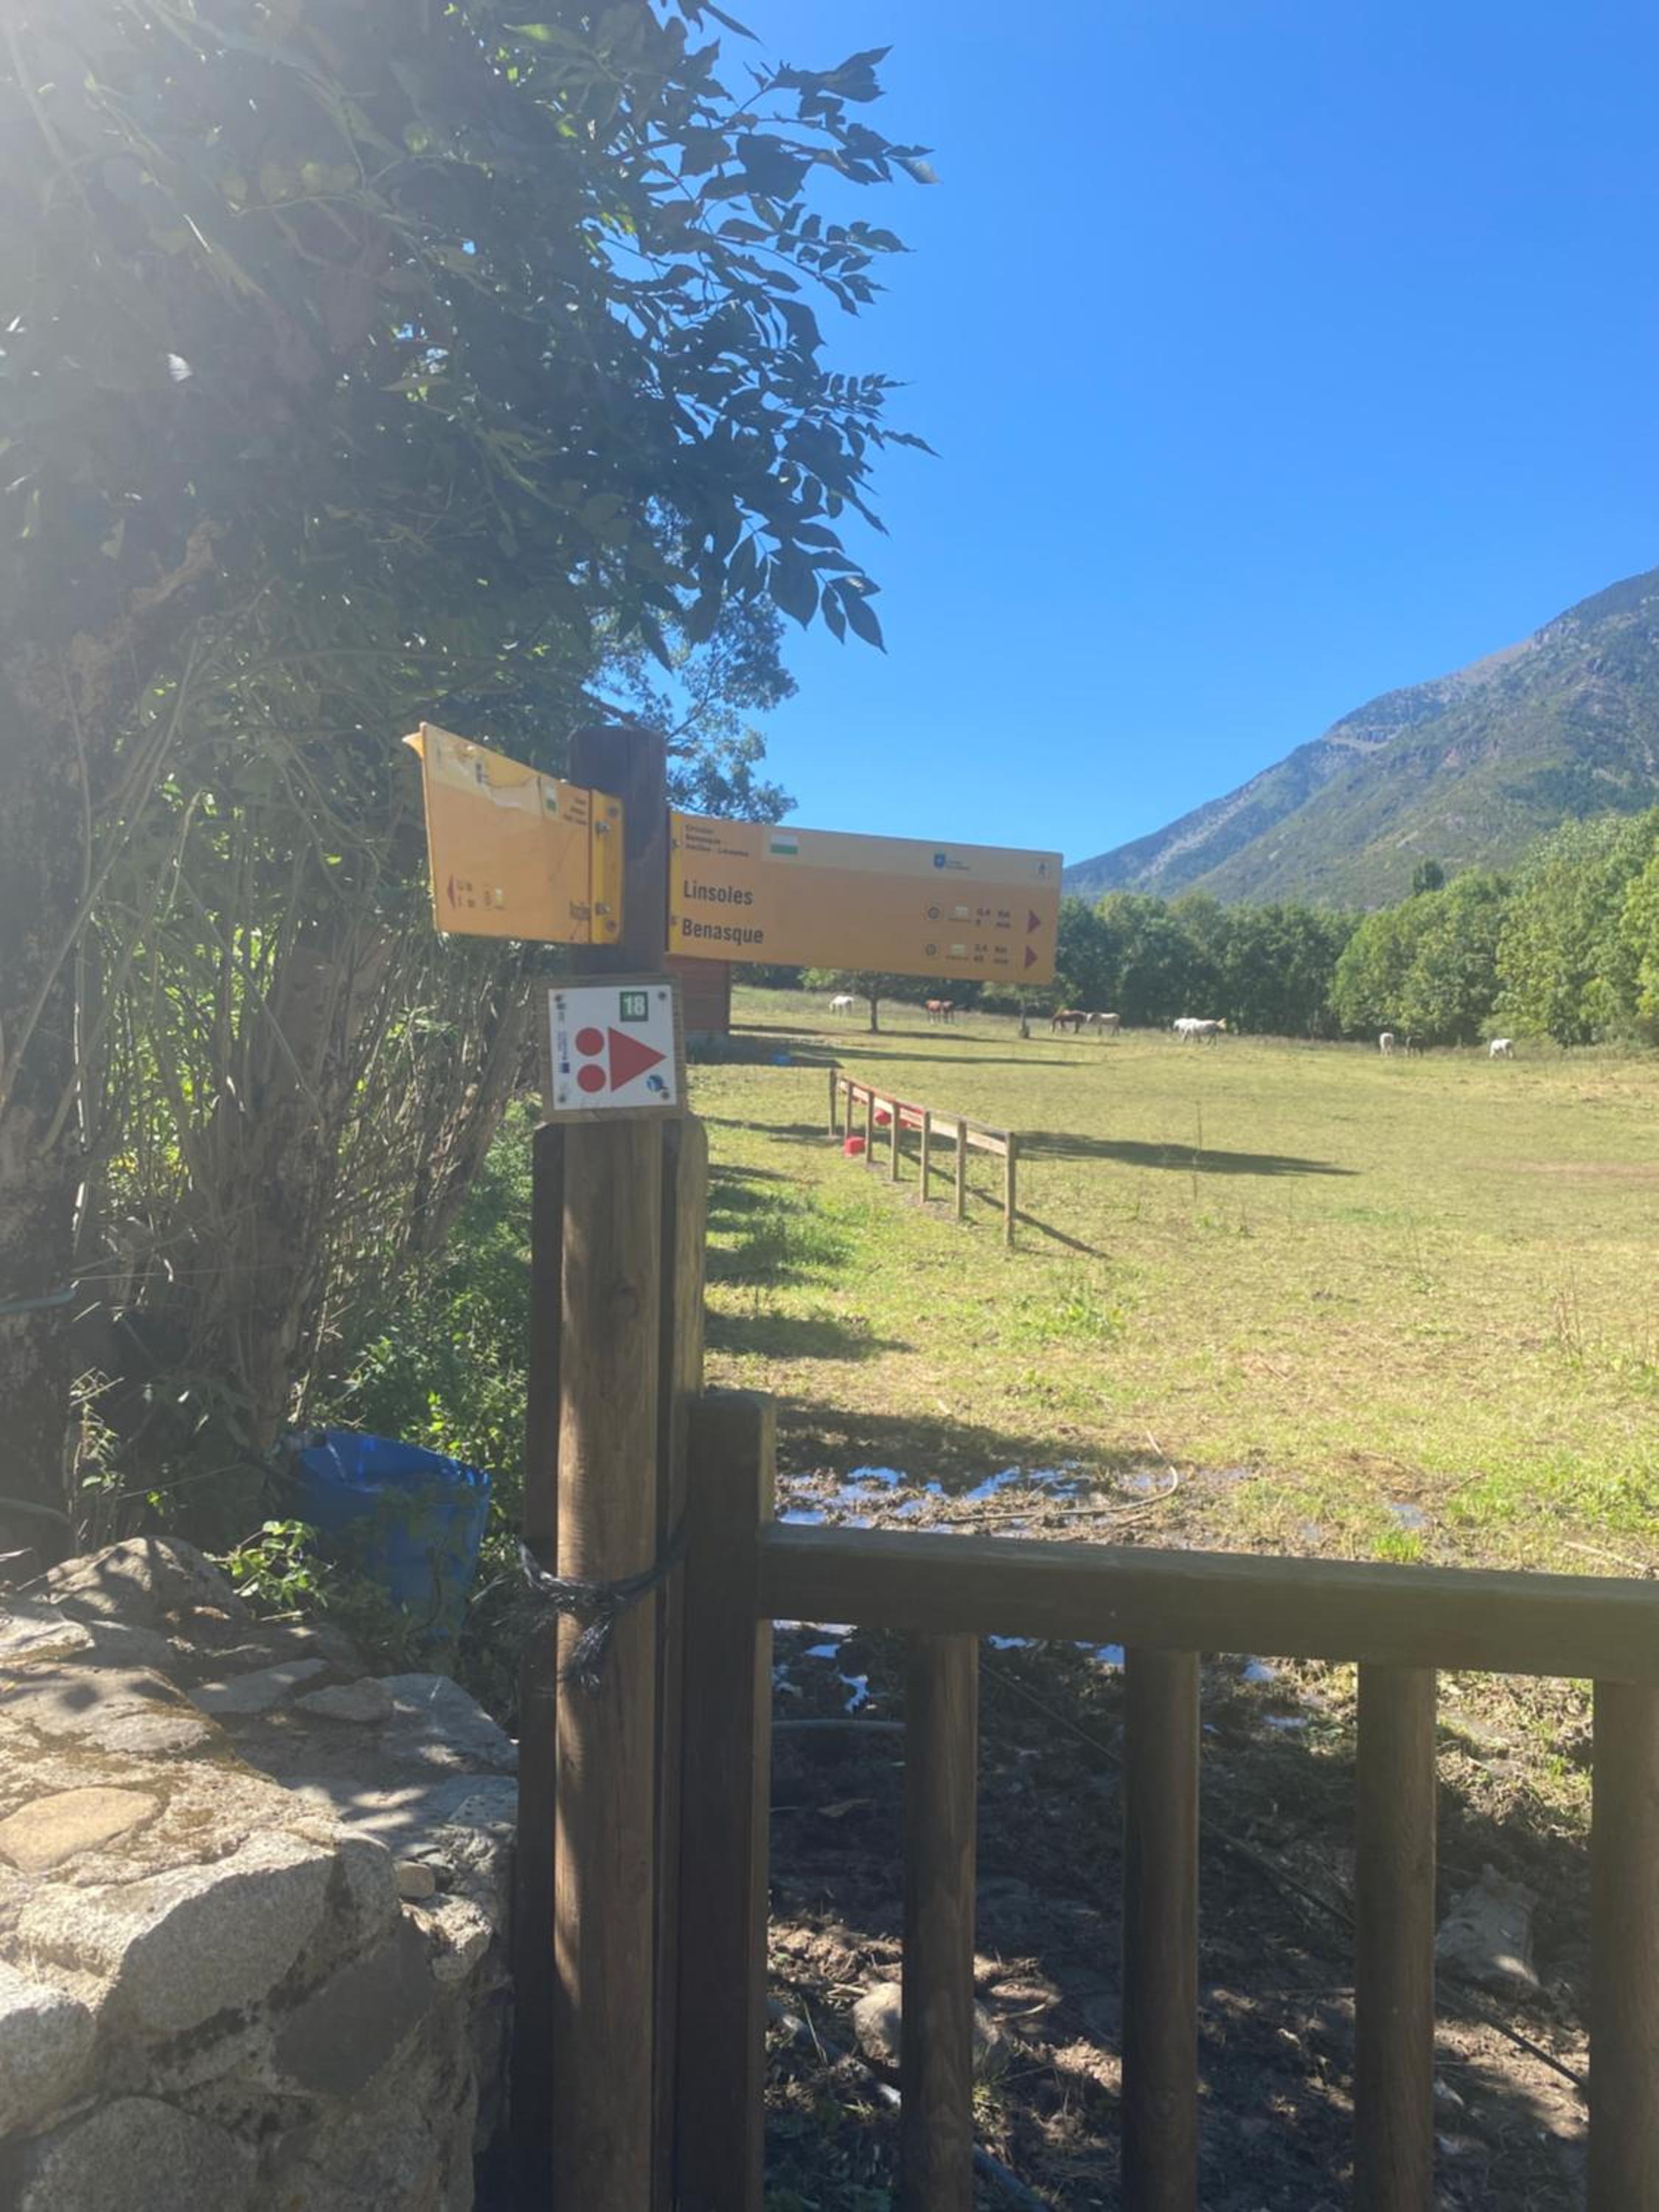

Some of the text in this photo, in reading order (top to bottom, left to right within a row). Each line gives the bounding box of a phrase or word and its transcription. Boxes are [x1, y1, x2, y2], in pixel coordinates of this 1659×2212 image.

[684, 880, 754, 906] Linsoles
[682, 918, 764, 945] Benasque
[623, 995, 645, 1016] 18
